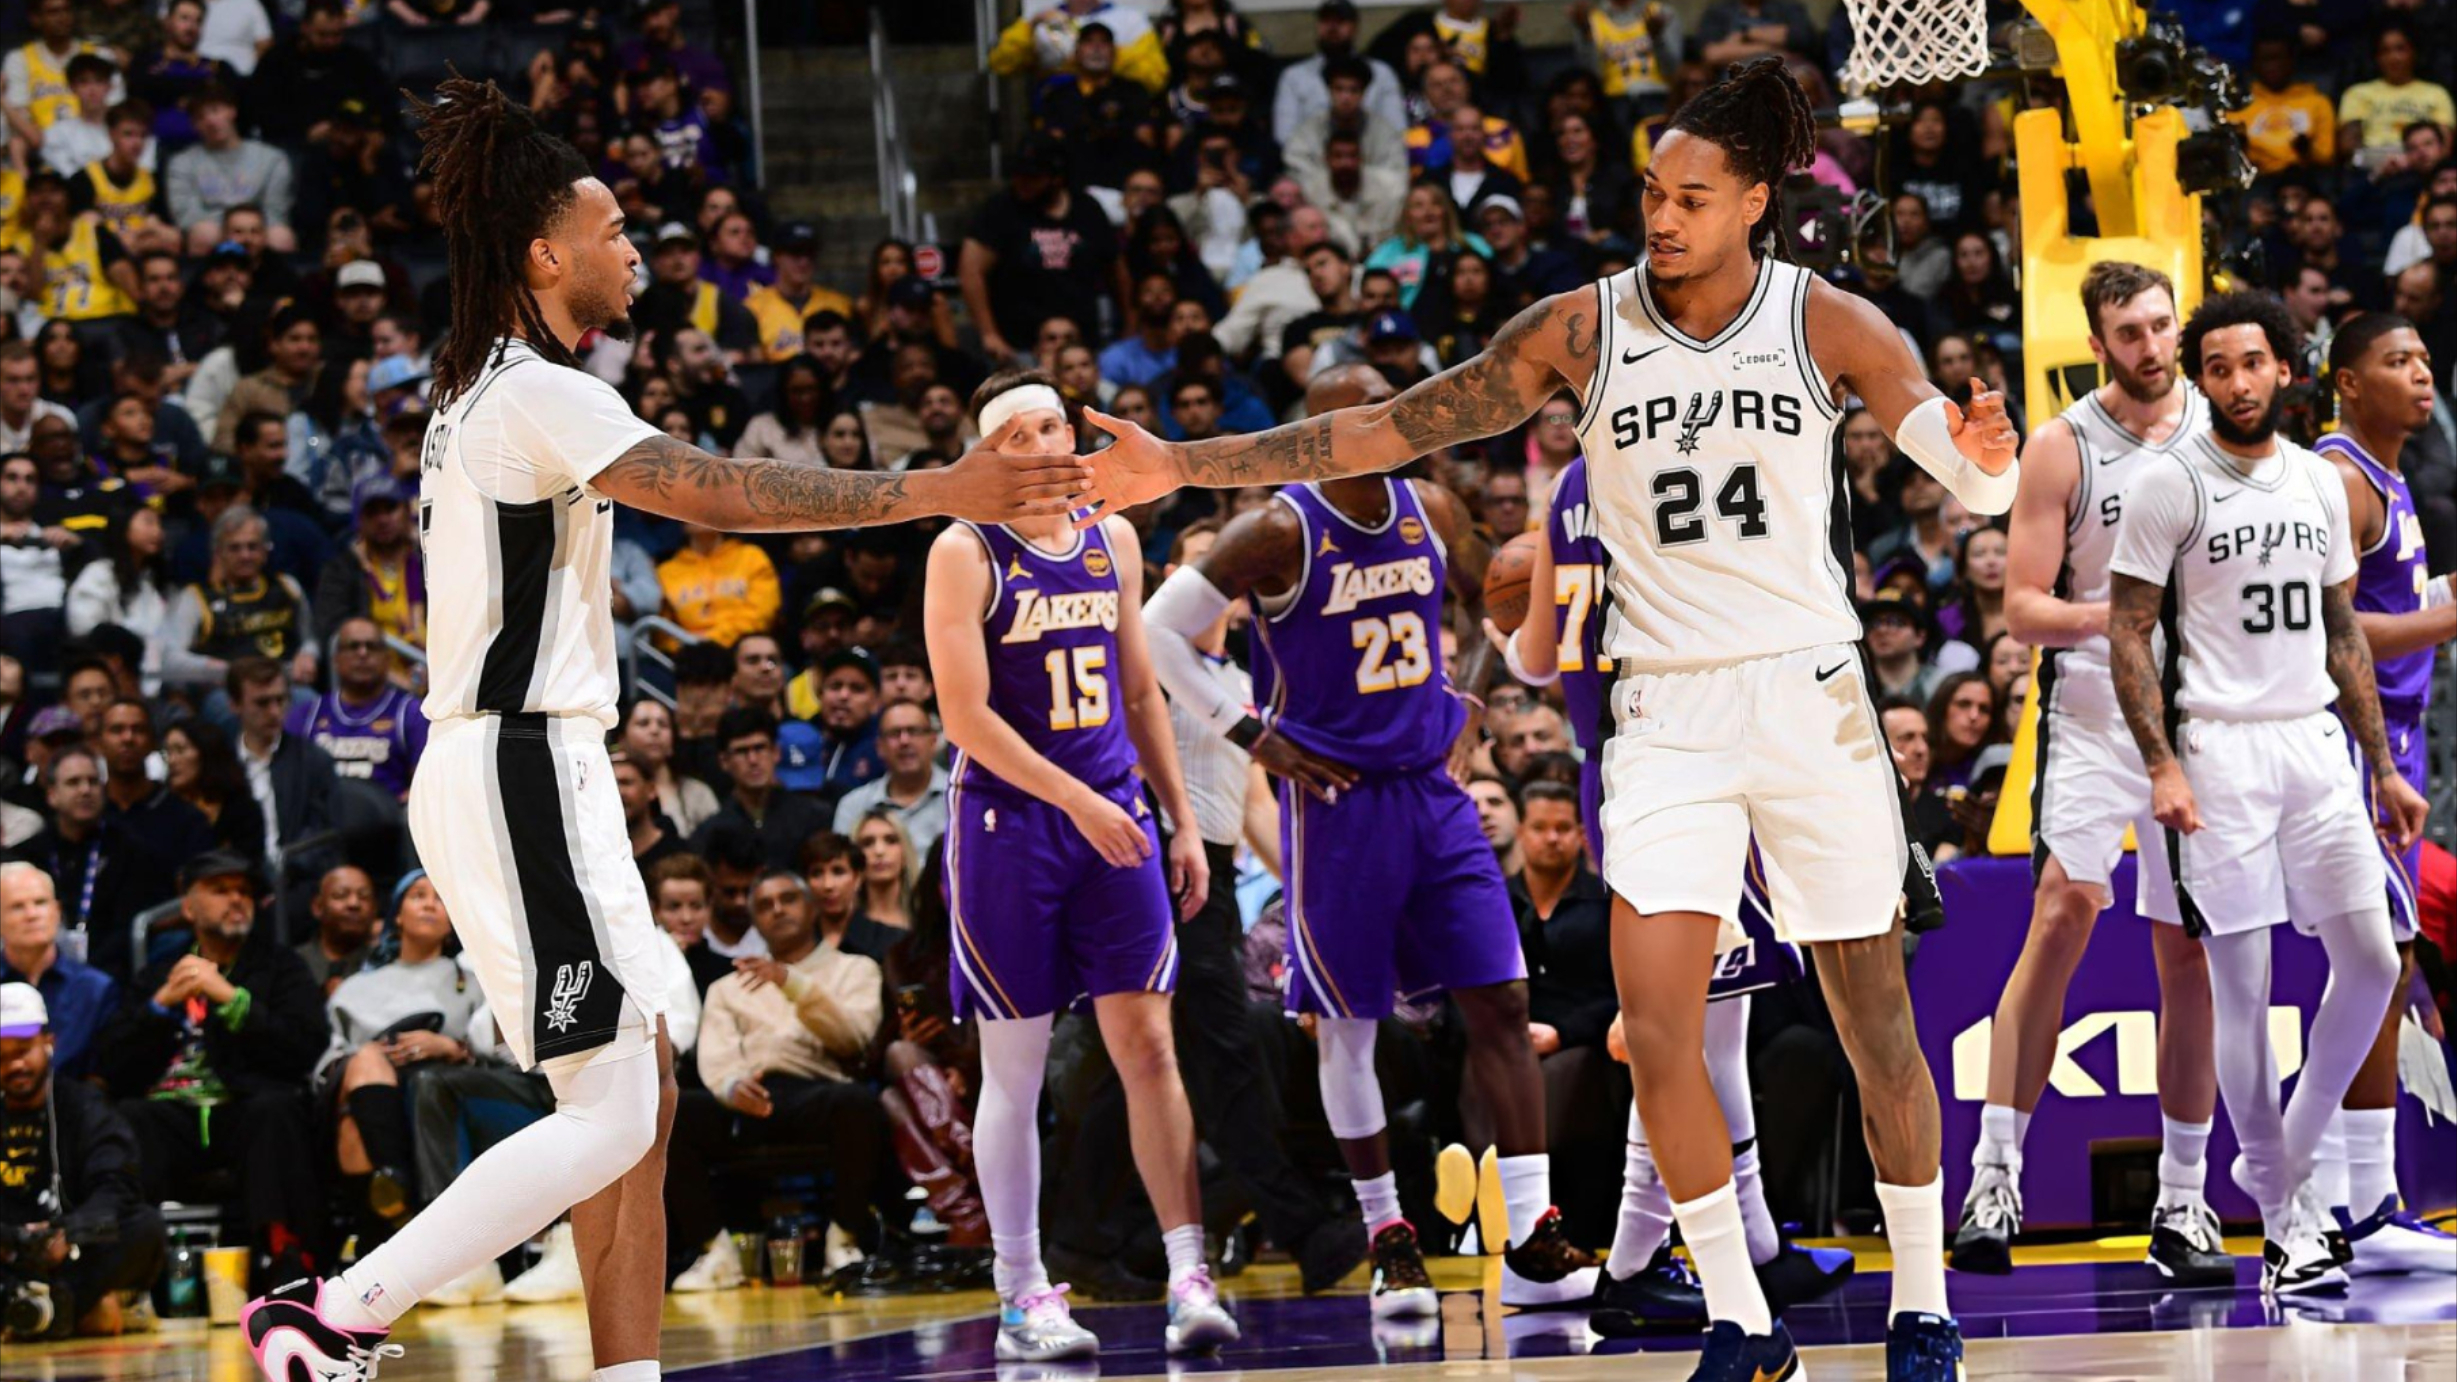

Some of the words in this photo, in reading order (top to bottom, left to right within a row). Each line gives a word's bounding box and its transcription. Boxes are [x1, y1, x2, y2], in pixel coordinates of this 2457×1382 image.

[1738, 353, 1780, 365] LEDGER
[1611, 389, 1802, 456] SPURS
[1650, 462, 1771, 549] 24
[2207, 522, 2328, 567] SPURS
[1000, 588, 1119, 644] LAKERS
[1320, 555, 1435, 616] LAKERS
[2242, 581, 2312, 633] 30
[1351, 611, 1432, 694] 23
[1045, 645, 1110, 731] 15
